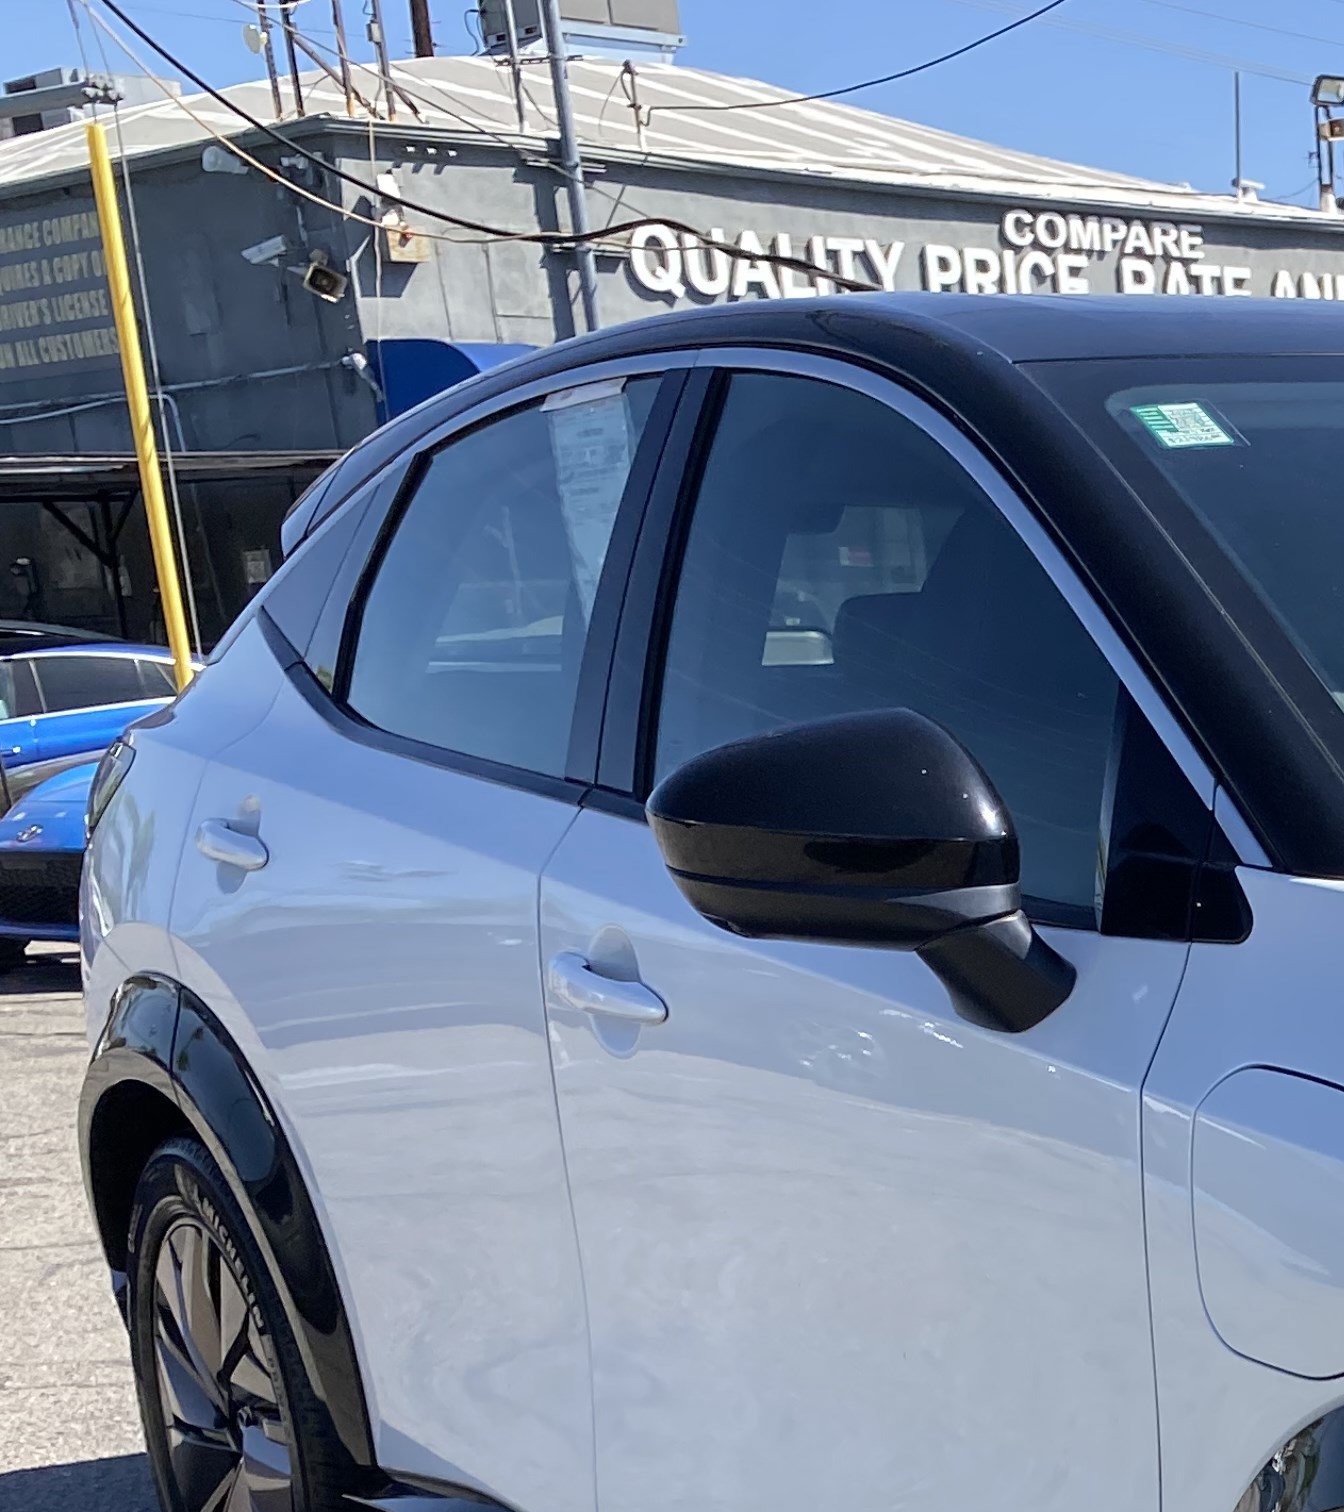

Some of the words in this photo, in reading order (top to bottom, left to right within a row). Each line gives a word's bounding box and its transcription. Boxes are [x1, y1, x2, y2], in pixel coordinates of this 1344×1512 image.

[629, 223, 905, 299] QUALITY
[923, 243, 1091, 296] PRICE
[1117, 256, 1252, 297] RATE
[1003, 209, 1206, 259] COMPARE
